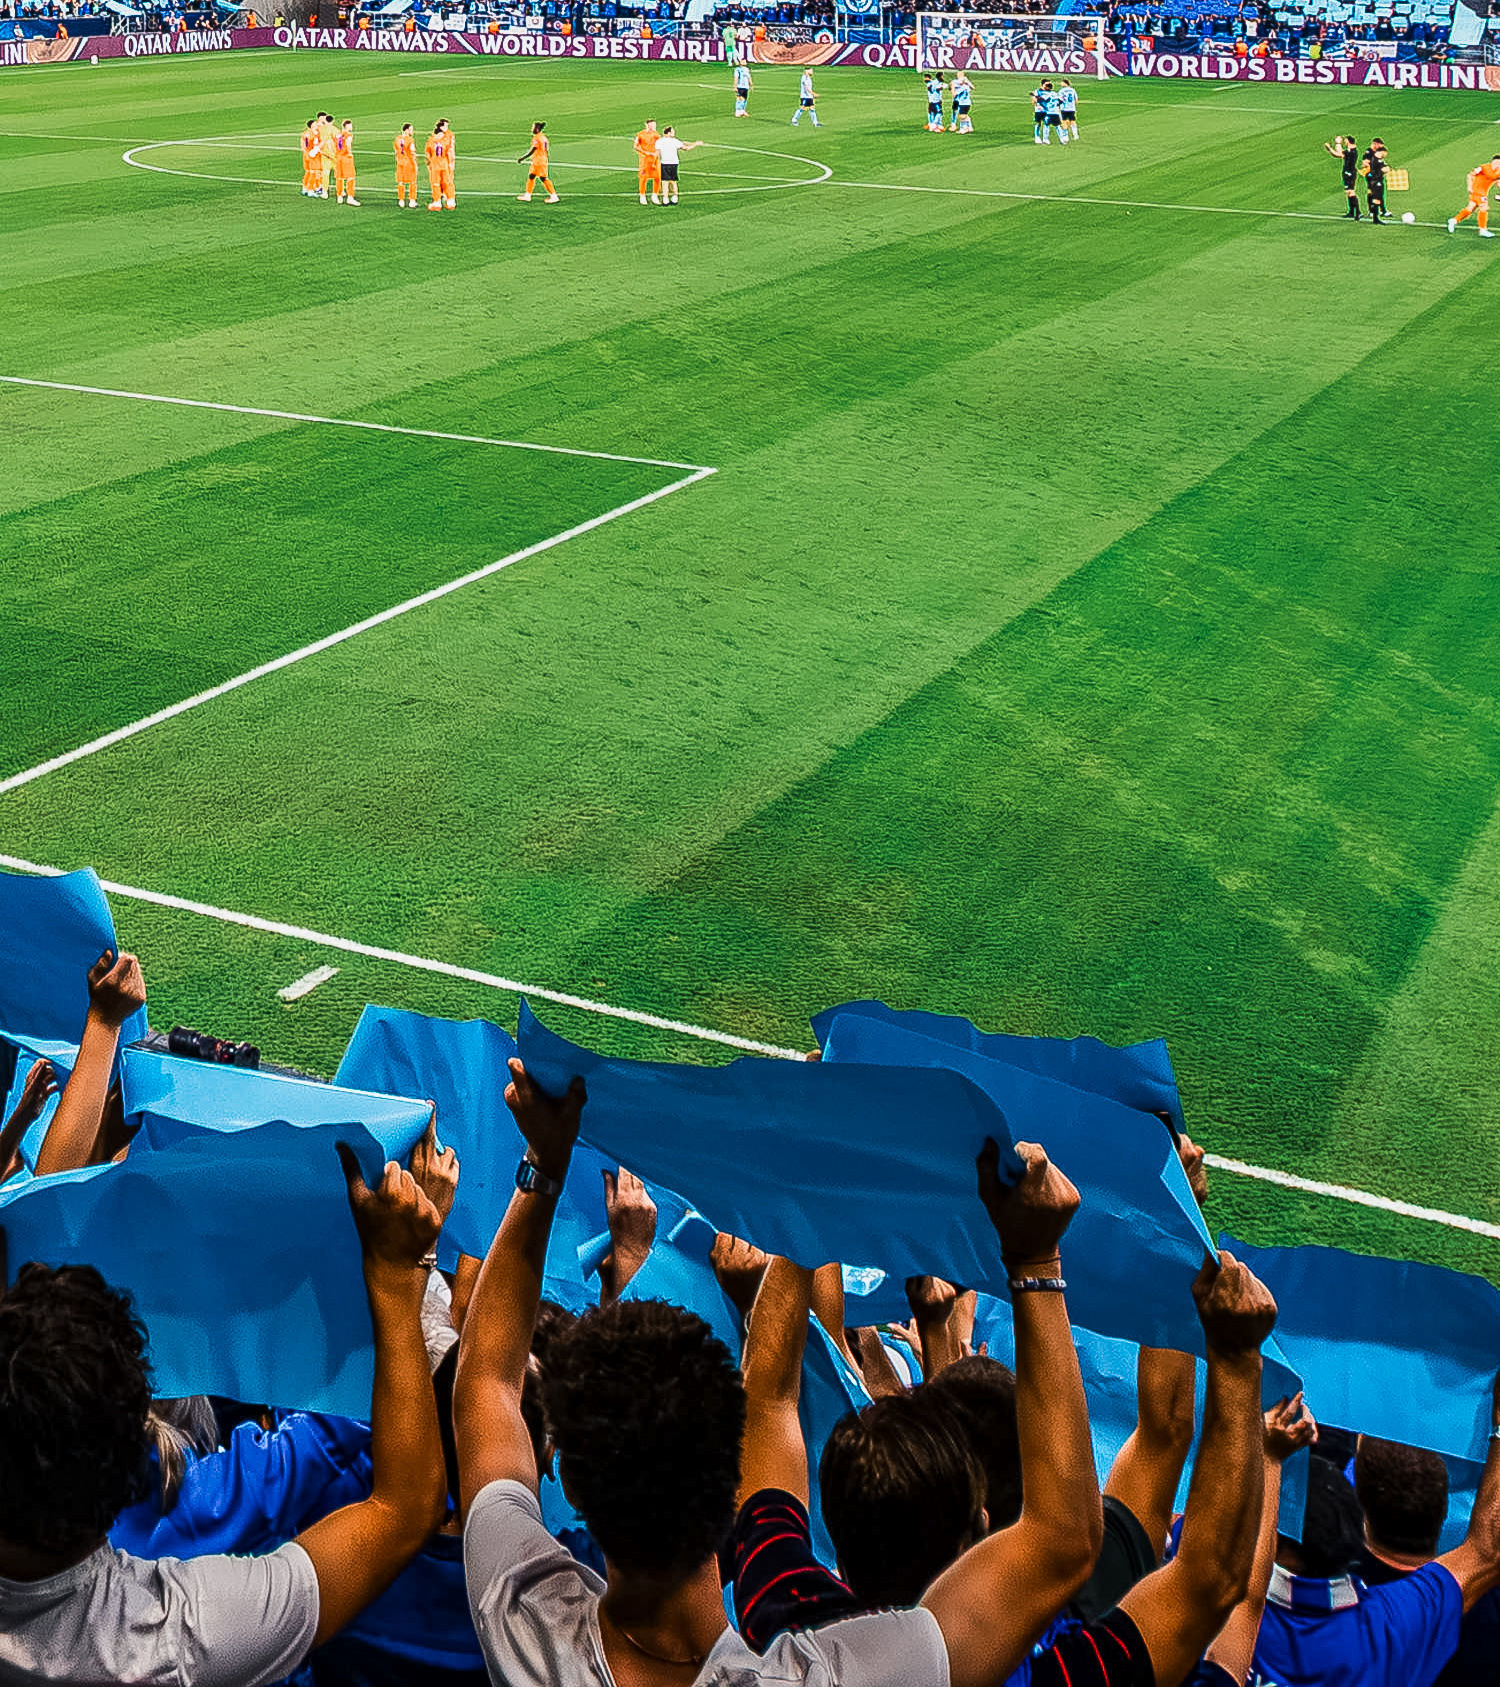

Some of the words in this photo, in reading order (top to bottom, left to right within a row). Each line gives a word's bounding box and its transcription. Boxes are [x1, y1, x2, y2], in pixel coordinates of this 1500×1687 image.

[124, 32, 172, 57] QATAR
[175, 30, 231, 52] AIRWAYS
[273, 27, 347, 48] QATAR
[354, 30, 449, 53] AIRWAYS
[480, 33, 588, 58] WORLD'S
[594, 37, 654, 59] BEST
[862, 45, 955, 69] QATAR
[965, 47, 1086, 74] AIRWAYS
[1131, 53, 1266, 80] WORLD'S
[1275, 60, 1354, 84] BEST
